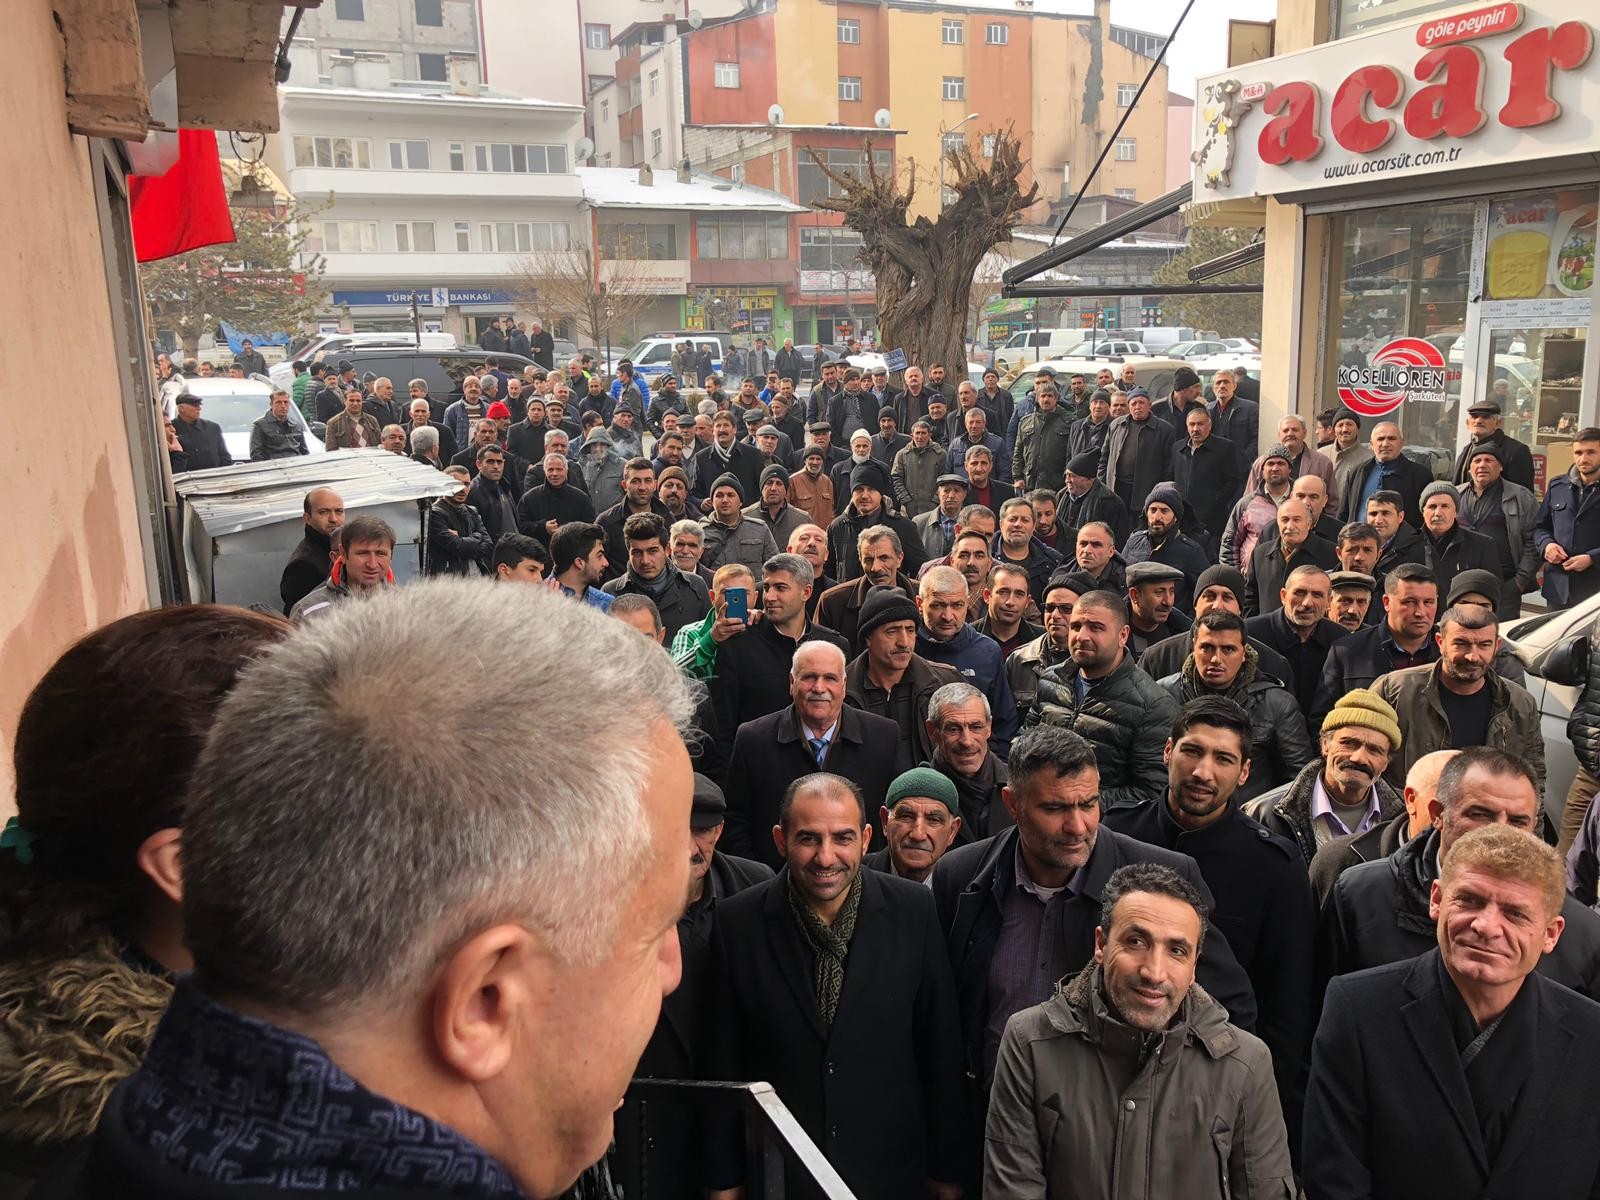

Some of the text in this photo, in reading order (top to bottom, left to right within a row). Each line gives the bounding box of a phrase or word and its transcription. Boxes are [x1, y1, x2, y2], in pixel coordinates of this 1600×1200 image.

[1425, 8, 1506, 44] göle peyniri
[1243, 84, 1264, 98] M&A
[1257, 19, 1593, 166] acar
[1323, 147, 1463, 179] www.acarsüt.com.tr
[1506, 207, 1548, 225] acar
[386, 292, 491, 302] TÜRKYE BANKASI
[1338, 365, 1446, 389] KÖSELİÖREN
[1408, 390, 1446, 402] Şarküteri
